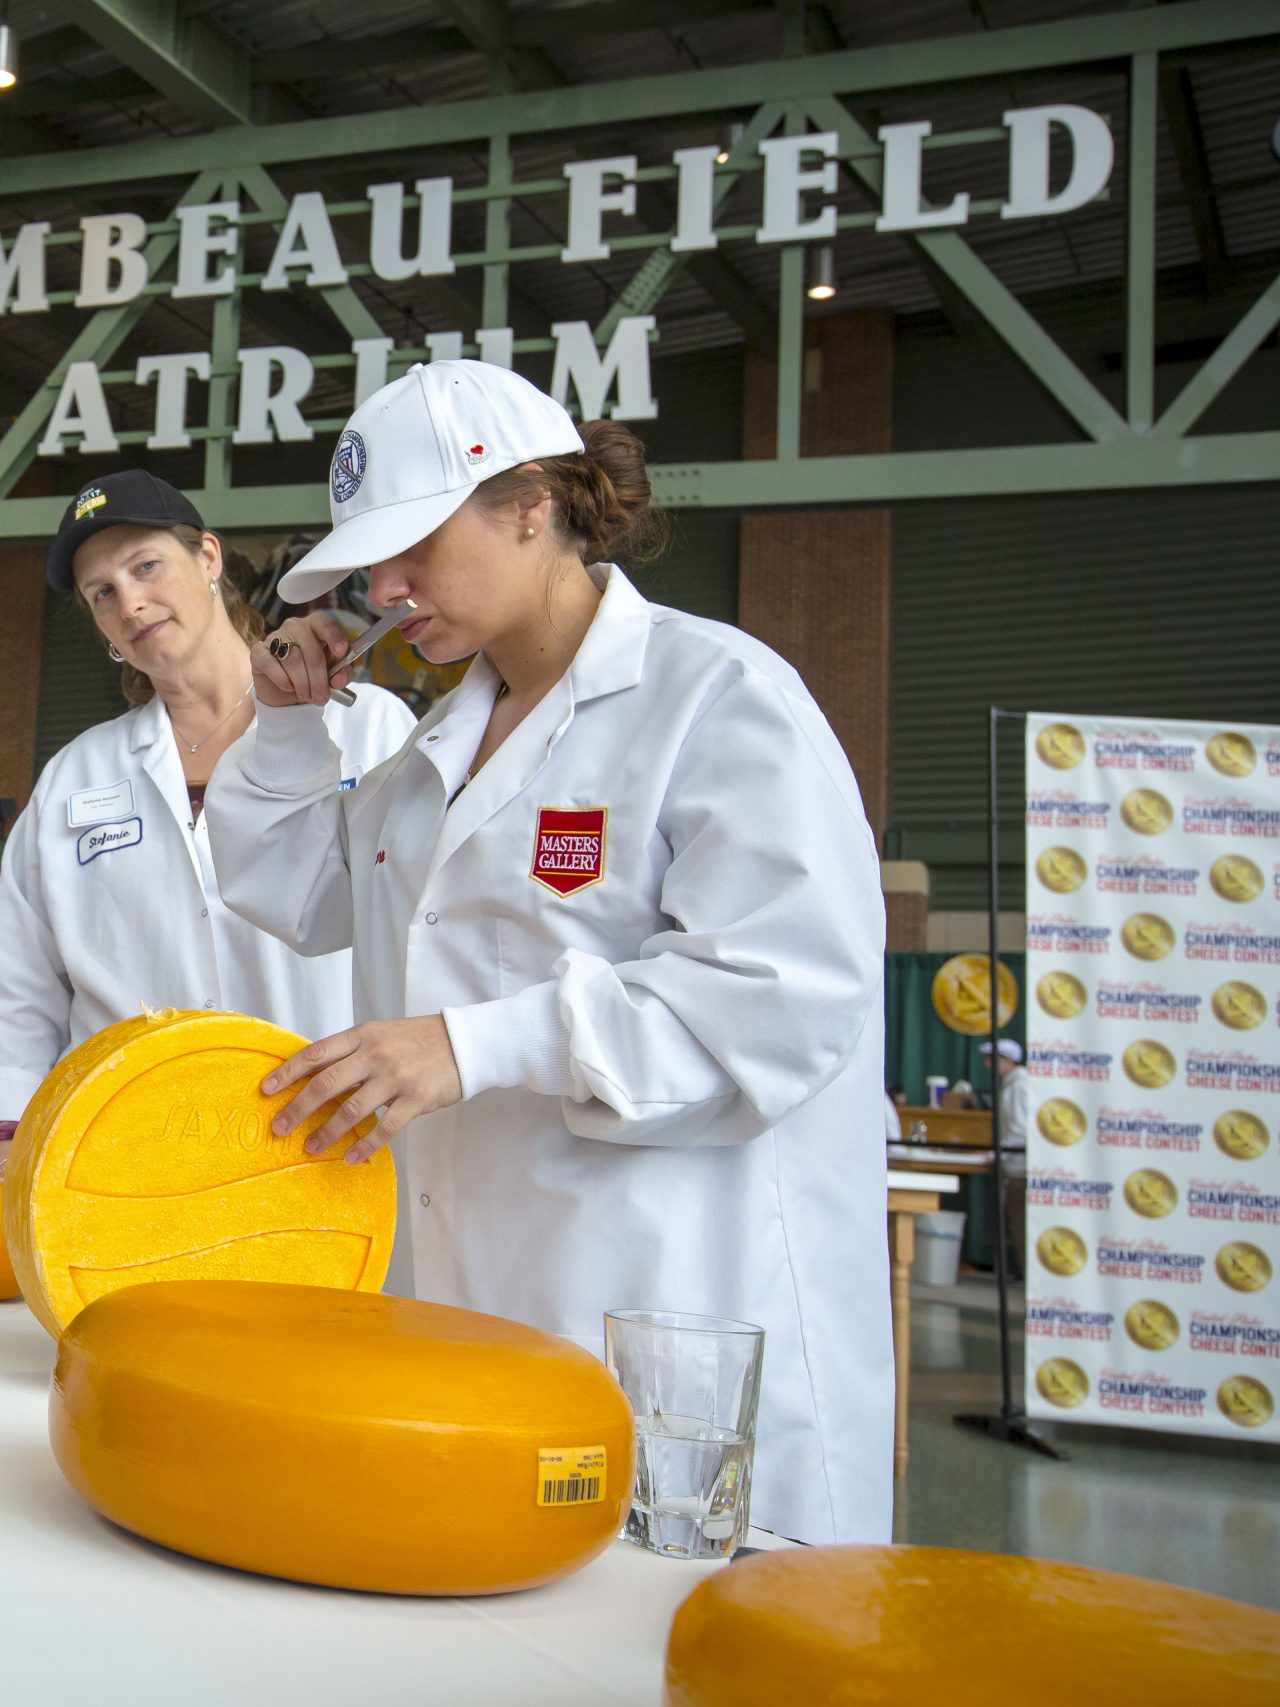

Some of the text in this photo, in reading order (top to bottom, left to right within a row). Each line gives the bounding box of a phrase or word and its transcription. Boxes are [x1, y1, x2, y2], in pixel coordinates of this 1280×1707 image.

[561, 103, 1114, 262] FIELD
[1094, 742, 1196, 757] CHAMPIONSHIP
[1095, 755, 1194, 773] CHEESE CONTEST
[1027, 800, 1111, 815] AMPIONSHIP
[1056, 814, 1109, 829] CONTEST
[1183, 821, 1225, 836] CHEESE
[540, 835, 599, 853] MASTERS
[538, 853, 599, 870] GALLERY
[1096, 864, 1199, 881] CHAMPIONSHIP
[1097, 878, 1196, 897] CHEESE CONTEST
[1027, 925, 1111, 940] AMPIONSHIP
[1056, 939, 1109, 954] CONTEST
[1186, 945, 1228, 961] CHEESE
[1097, 990, 1202, 1008] CHAMPIONSHIP
[1097, 1004, 1199, 1023] CHEESE CONTEST
[1027, 1050, 1112, 1066] AMPIONSHIP
[1057, 1065, 1110, 1082] CONTEST
[1187, 1073, 1231, 1090] CHEESE
[154, 1102, 292, 1155] SAXON
[1097, 1118, 1203, 1138] CHAMPIONSHIP
[1097, 1132, 1201, 1152] CHEESE CONTEST
[1027, 1177, 1113, 1195] AMPIONSHIP
[1058, 1192, 1111, 1210] CONTEST
[1188, 1203, 1233, 1220] CHEESE
[1097, 1248, 1205, 1269] CHAMPIONSHIP
[1097, 1262, 1202, 1284] CHEESE CONTEST
[1027, 1308, 1114, 1326] AMPIONSHIP
[1058, 1323, 1111, 1341] CONTEST
[1190, 1335, 1235, 1354] CHEESE
[1098, 1379, 1207, 1402] CHAMPIONSHIP
[1099, 1393, 1204, 1417] CHEESE CONTEST
